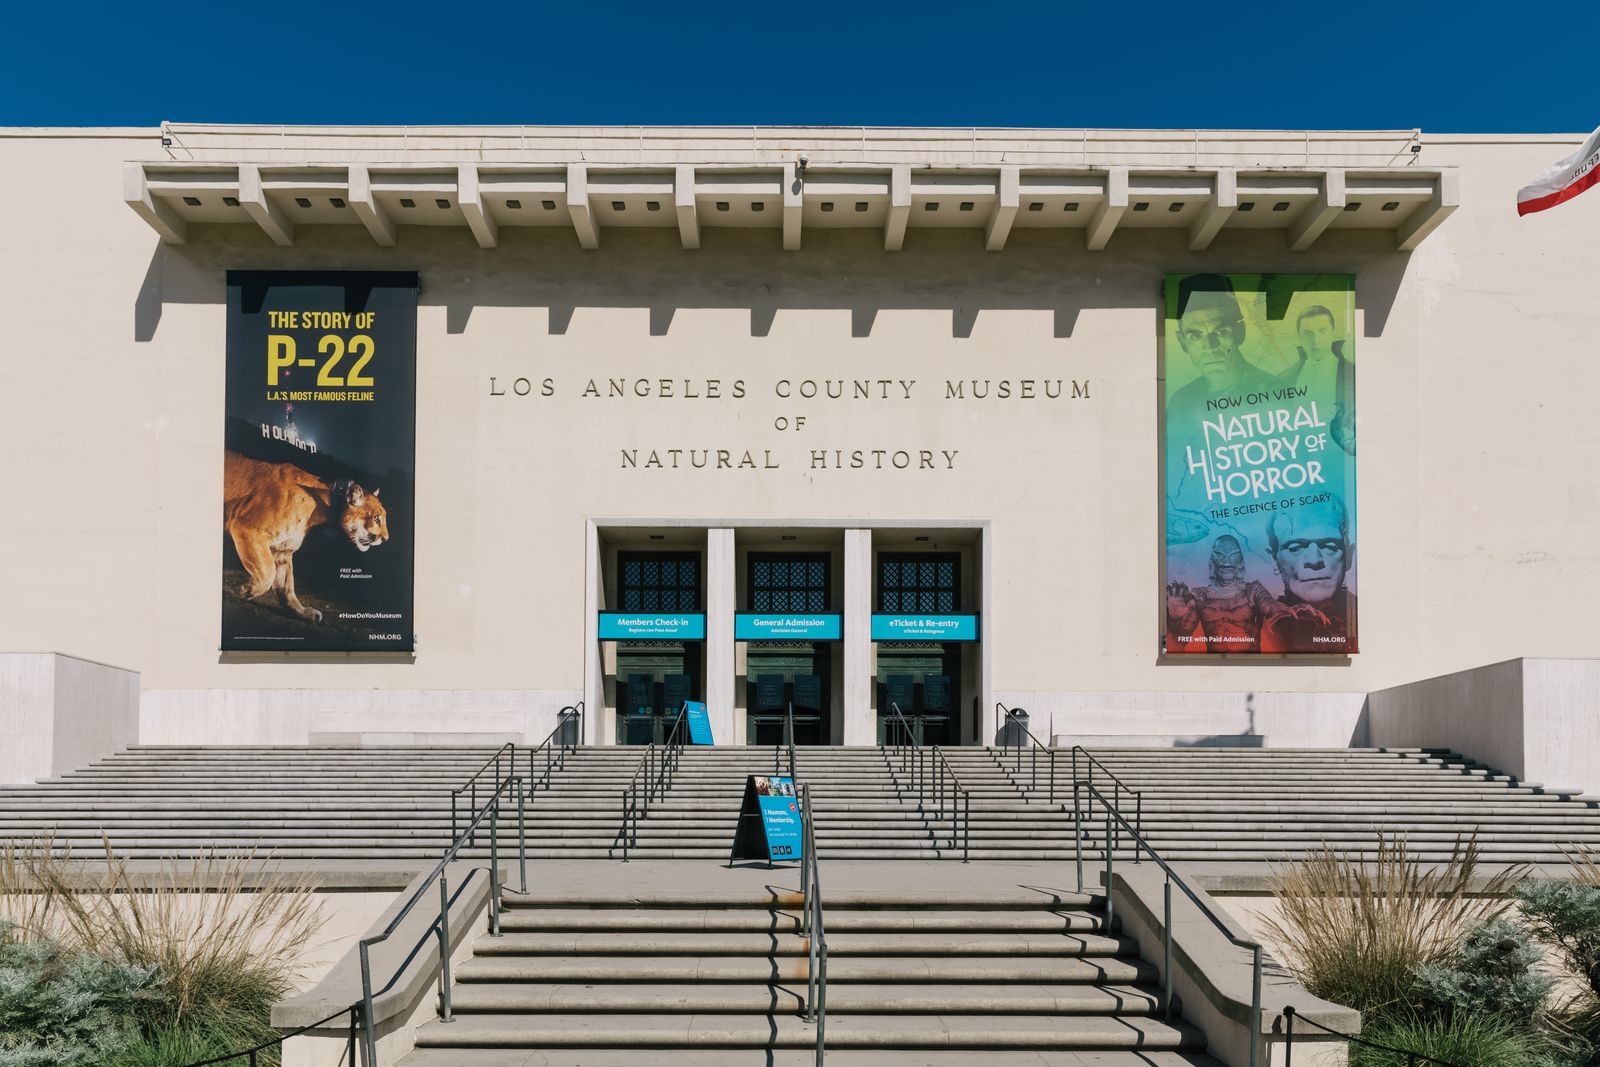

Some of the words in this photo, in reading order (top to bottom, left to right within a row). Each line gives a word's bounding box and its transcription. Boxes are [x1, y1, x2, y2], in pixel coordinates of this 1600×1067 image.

[268, 311, 298, 328] THE
[302, 312, 351, 329] STORY
[356, 312, 376, 329] OF
[267, 334, 375, 386] P-22
[267, 392, 288, 400] L.A.'S
[290, 392, 312, 400] MOST
[314, 392, 346, 400] FAMOUS
[348, 392, 374, 400] FELINE
[490, 377, 555, 396] LOS
[582, 378, 746, 398] ANGELES
[776, 380, 916, 398] COUNTY
[945, 380, 1090, 398] MUSEUM
[1206, 396, 1242, 412] NOW
[1246, 392, 1270, 404] ON
[1273, 385, 1308, 400] VIEW
[774, 416, 806, 430] OF
[1202, 401, 1326, 446] NATURAL
[621, 450, 780, 469] NATURAL
[810, 450, 958, 469] HISTORY
[1186, 435, 1300, 482] HISTORY
[1304, 433, 1327, 452] OF
[1206, 461, 1326, 504] HORROR
[1210, 509, 1230, 520] THE
[1234, 502, 1278, 516] SCIENCE
[1280, 498, 1296, 508] OF
[1299, 493, 1332, 506] SCARY
[926, 620, 959, 629] Re-entry
